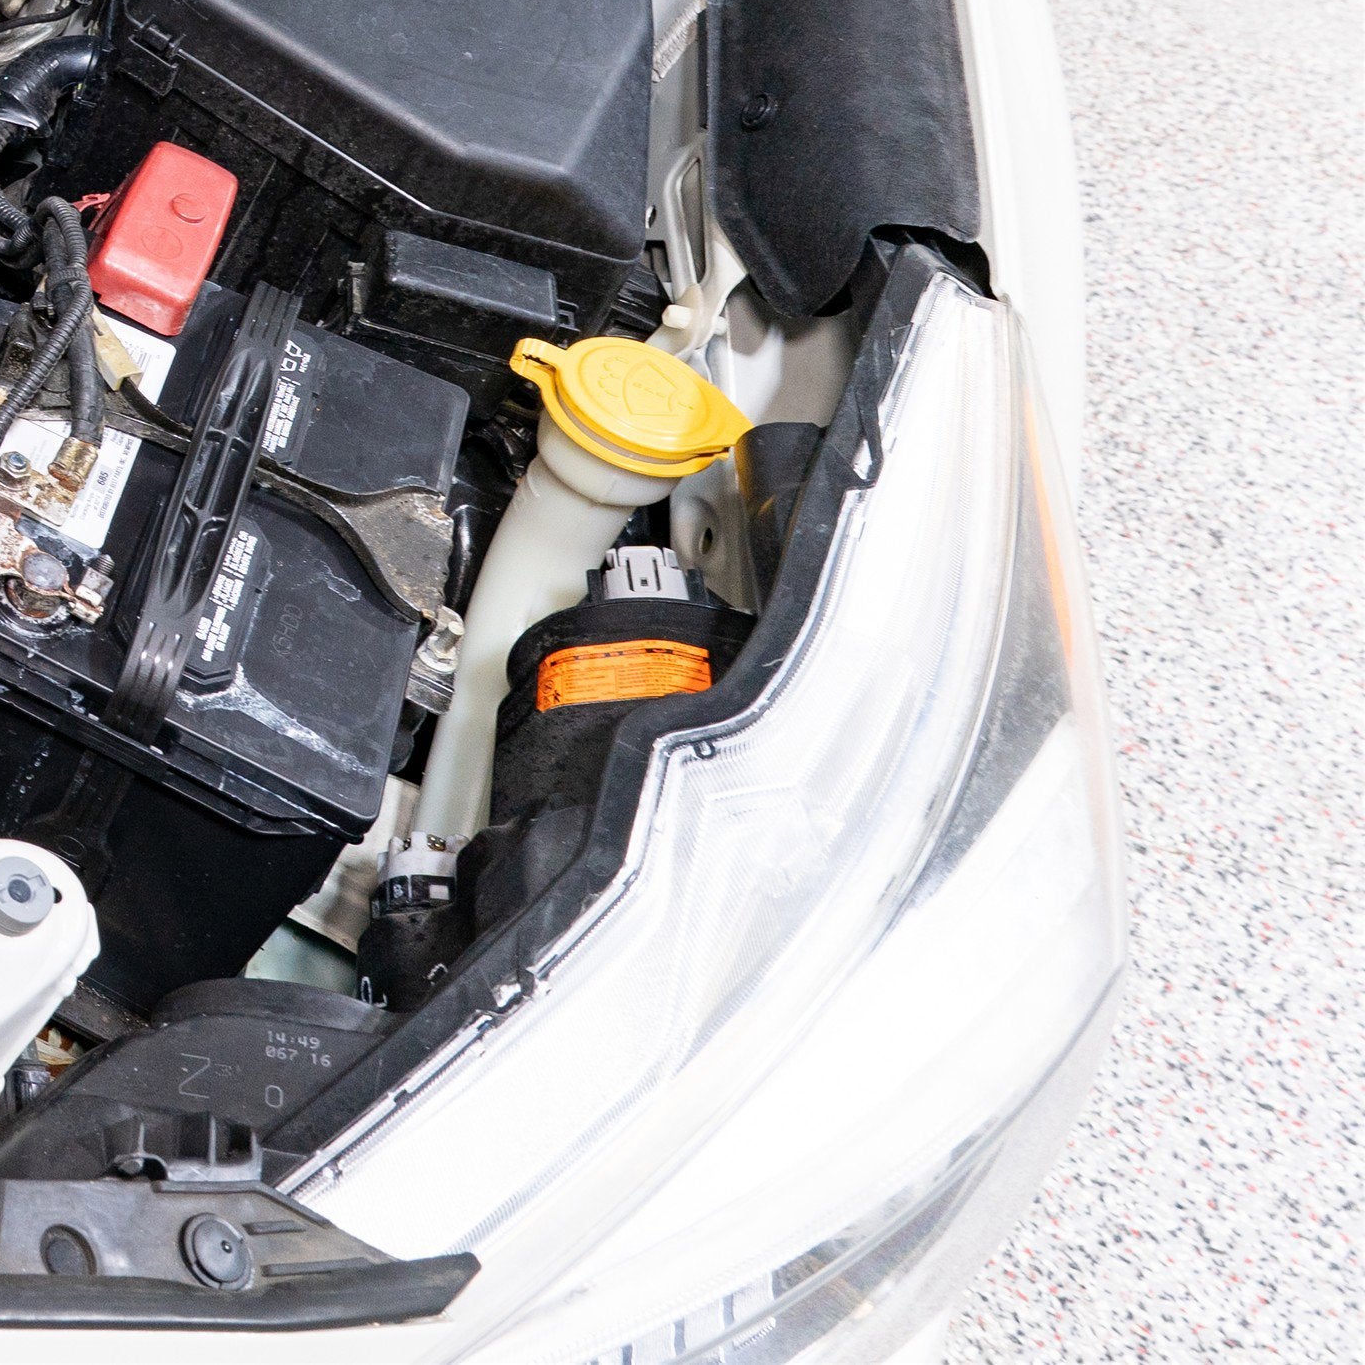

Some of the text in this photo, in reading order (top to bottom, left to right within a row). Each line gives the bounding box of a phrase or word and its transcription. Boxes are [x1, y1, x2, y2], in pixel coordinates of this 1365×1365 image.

[96, 471, 110, 487] 685
[267, 1030, 321, 1050] 14:49
[265, 1044, 332, 1069] 067 16
[178, 1052, 211, 1100] Z
